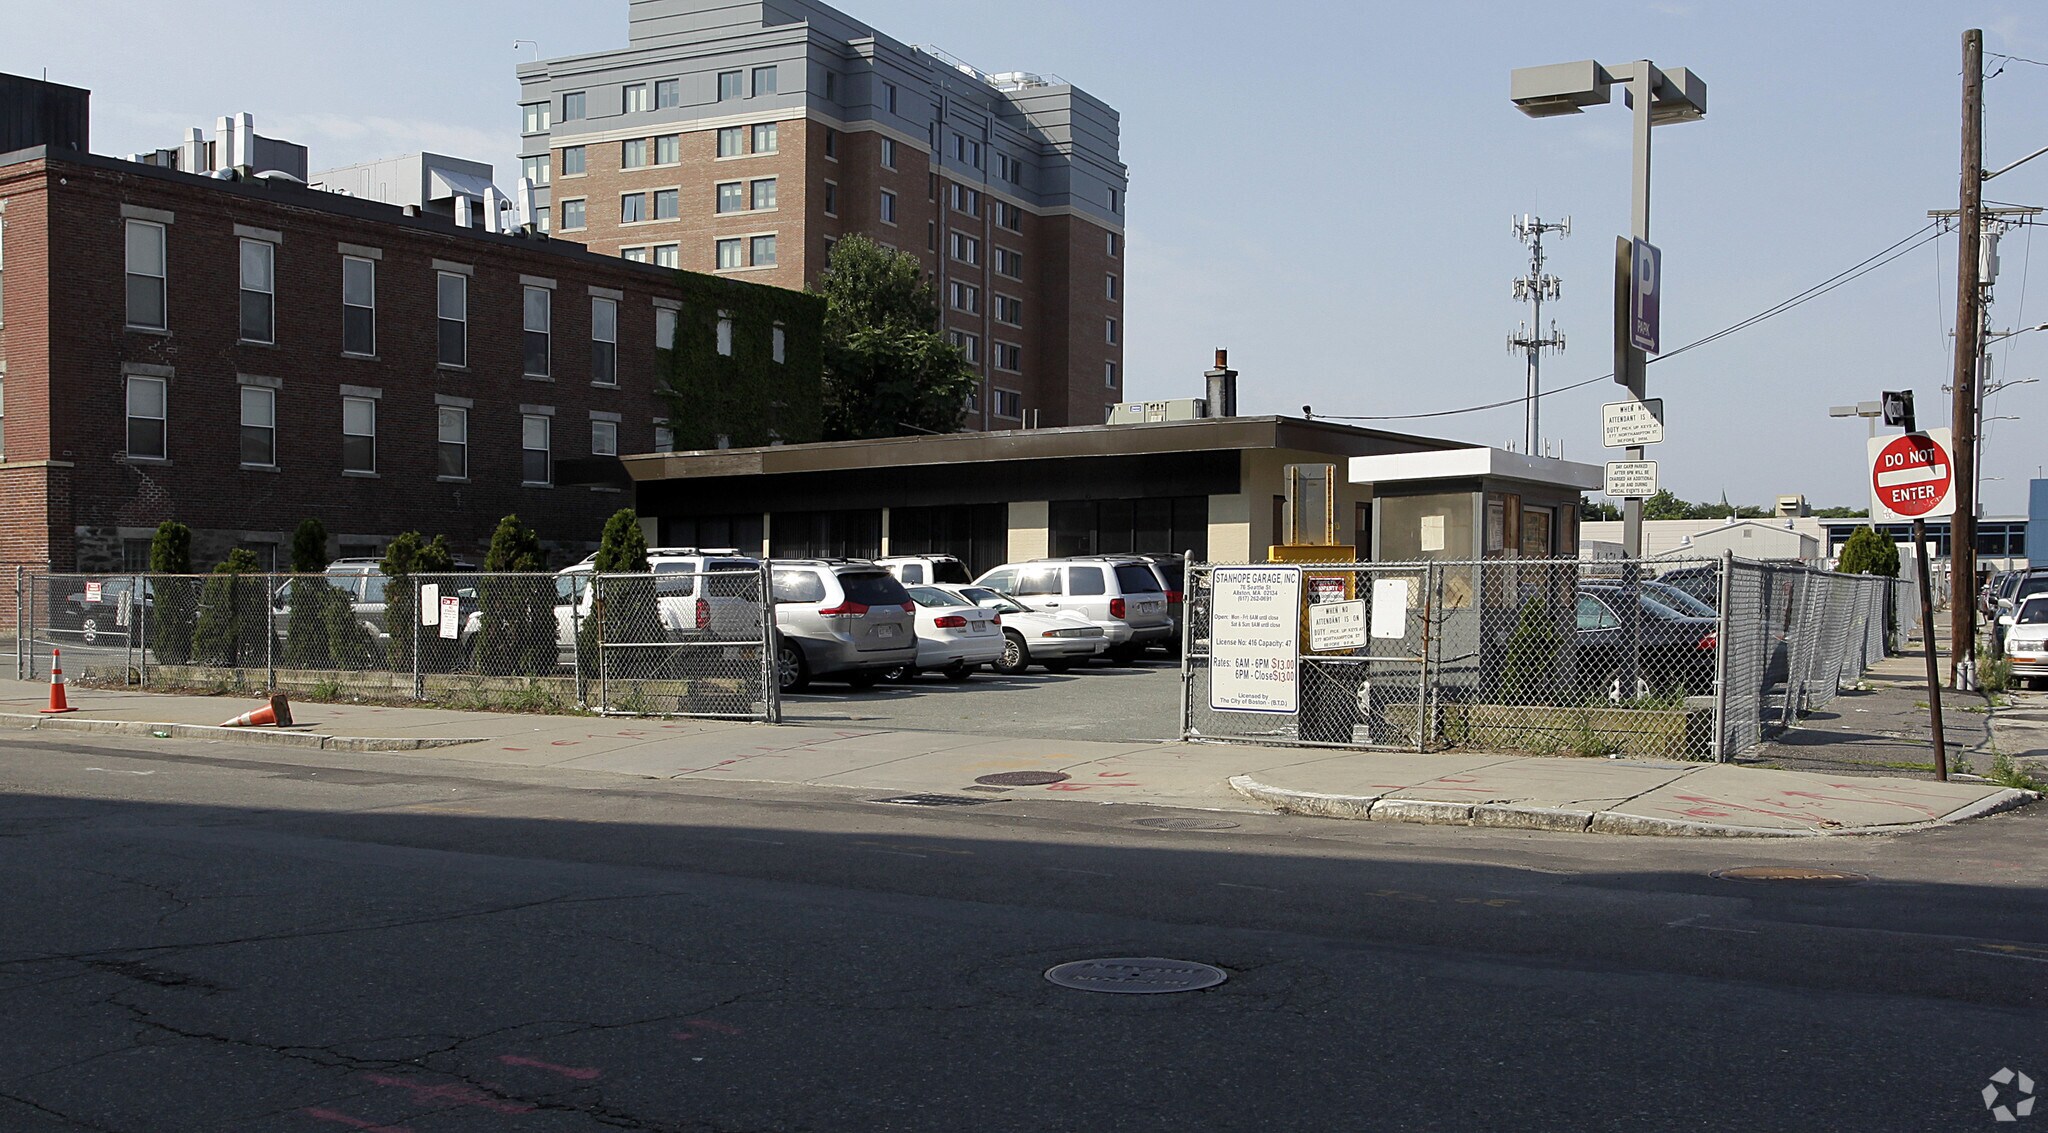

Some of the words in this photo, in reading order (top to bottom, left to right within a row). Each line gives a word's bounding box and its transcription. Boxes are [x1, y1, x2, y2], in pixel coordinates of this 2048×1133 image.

[1638, 244, 1654, 319] P
[1609, 415, 1636, 423] ATTENDANT
[1606, 426, 1619, 434] DUTY
[1885, 453, 1904, 467] DO
[1909, 448, 1935, 464] NOT
[1892, 485, 1935, 502] ENTER
[1216, 573, 1251, 584] STANHOPE
[1252, 573, 1283, 585] GARAGE,
[1325, 606, 1339, 614] WHEN
[1316, 616, 1341, 626] ATTENDANT
[1314, 628, 1326, 636] DUTY
[1216, 638, 1237, 646] License
[1285, 639, 1292, 647] 47
[1213, 657, 1232, 668] Rates:
[1235, 657, 1250, 668] 6AM
[1254, 658, 1270, 669] 6PM
[1270, 657, 1294, 670] $13.00
[1235, 669, 1249, 679] 6PM
